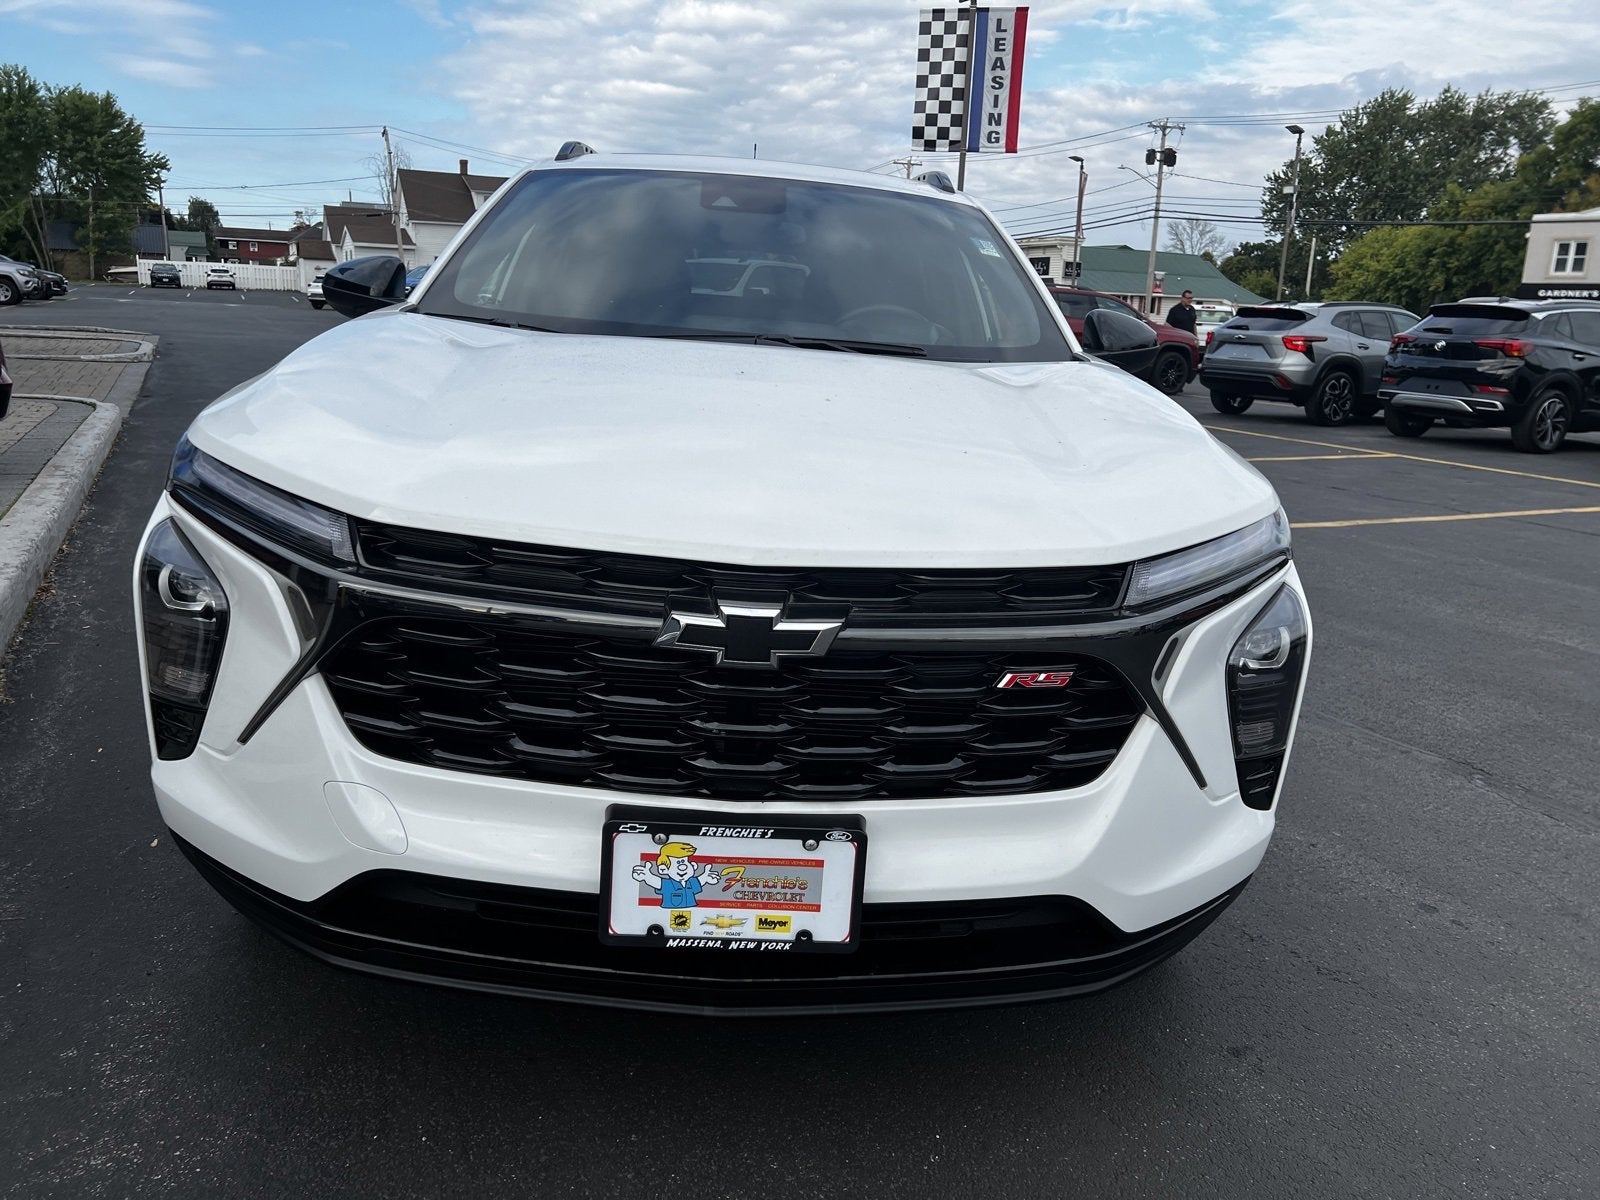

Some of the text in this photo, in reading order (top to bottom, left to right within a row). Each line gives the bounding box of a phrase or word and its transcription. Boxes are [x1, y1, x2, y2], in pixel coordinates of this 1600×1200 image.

[986, 18, 1008, 144] LEASING
[1537, 289, 1600, 298] GARDNER'S
[996, 672, 1074, 689] RS
[699, 826, 774, 839] FRENCHIE'S
[720, 866, 808, 892] Frenchie's
[733, 890, 806, 903] CHEVROLET
[757, 917, 789, 930] Meyer
[728, 941, 757, 950] NEW
[759, 942, 793, 951] YORK
